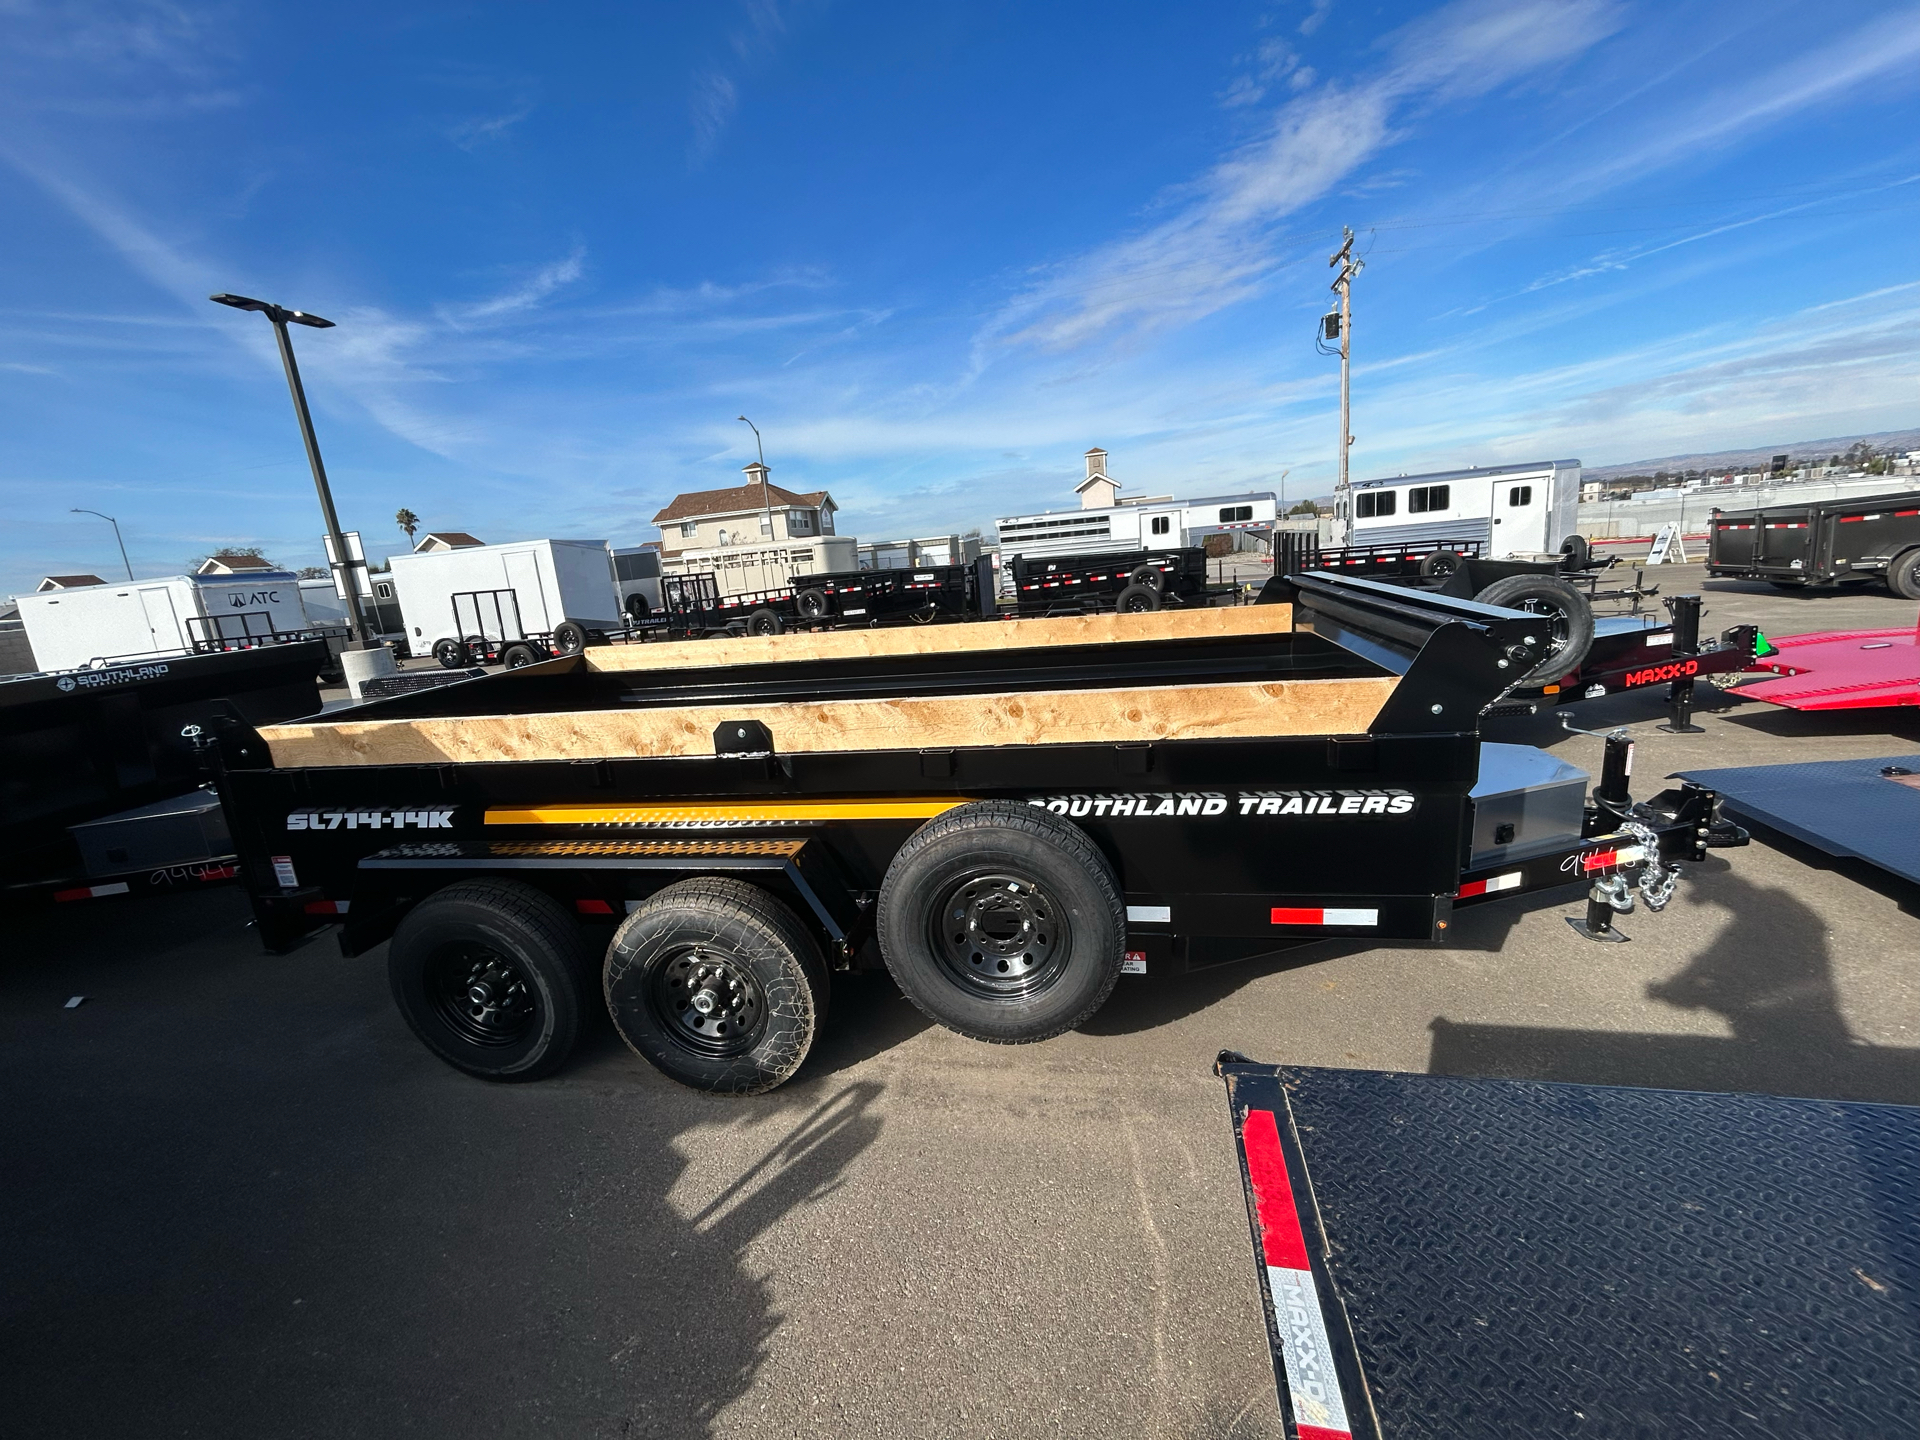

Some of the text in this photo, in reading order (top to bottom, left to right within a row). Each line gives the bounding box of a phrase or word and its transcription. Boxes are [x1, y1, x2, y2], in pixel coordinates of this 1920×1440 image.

[249, 591, 280, 605] ATC
[77, 664, 169, 685] SOUTHLAND
[1626, 660, 1698, 687] MAXX-D
[1238, 795, 1415, 815] TRAILERS
[286, 810, 455, 830] SL714-14K
[1283, 1284, 1326, 1401] MAXX-D
